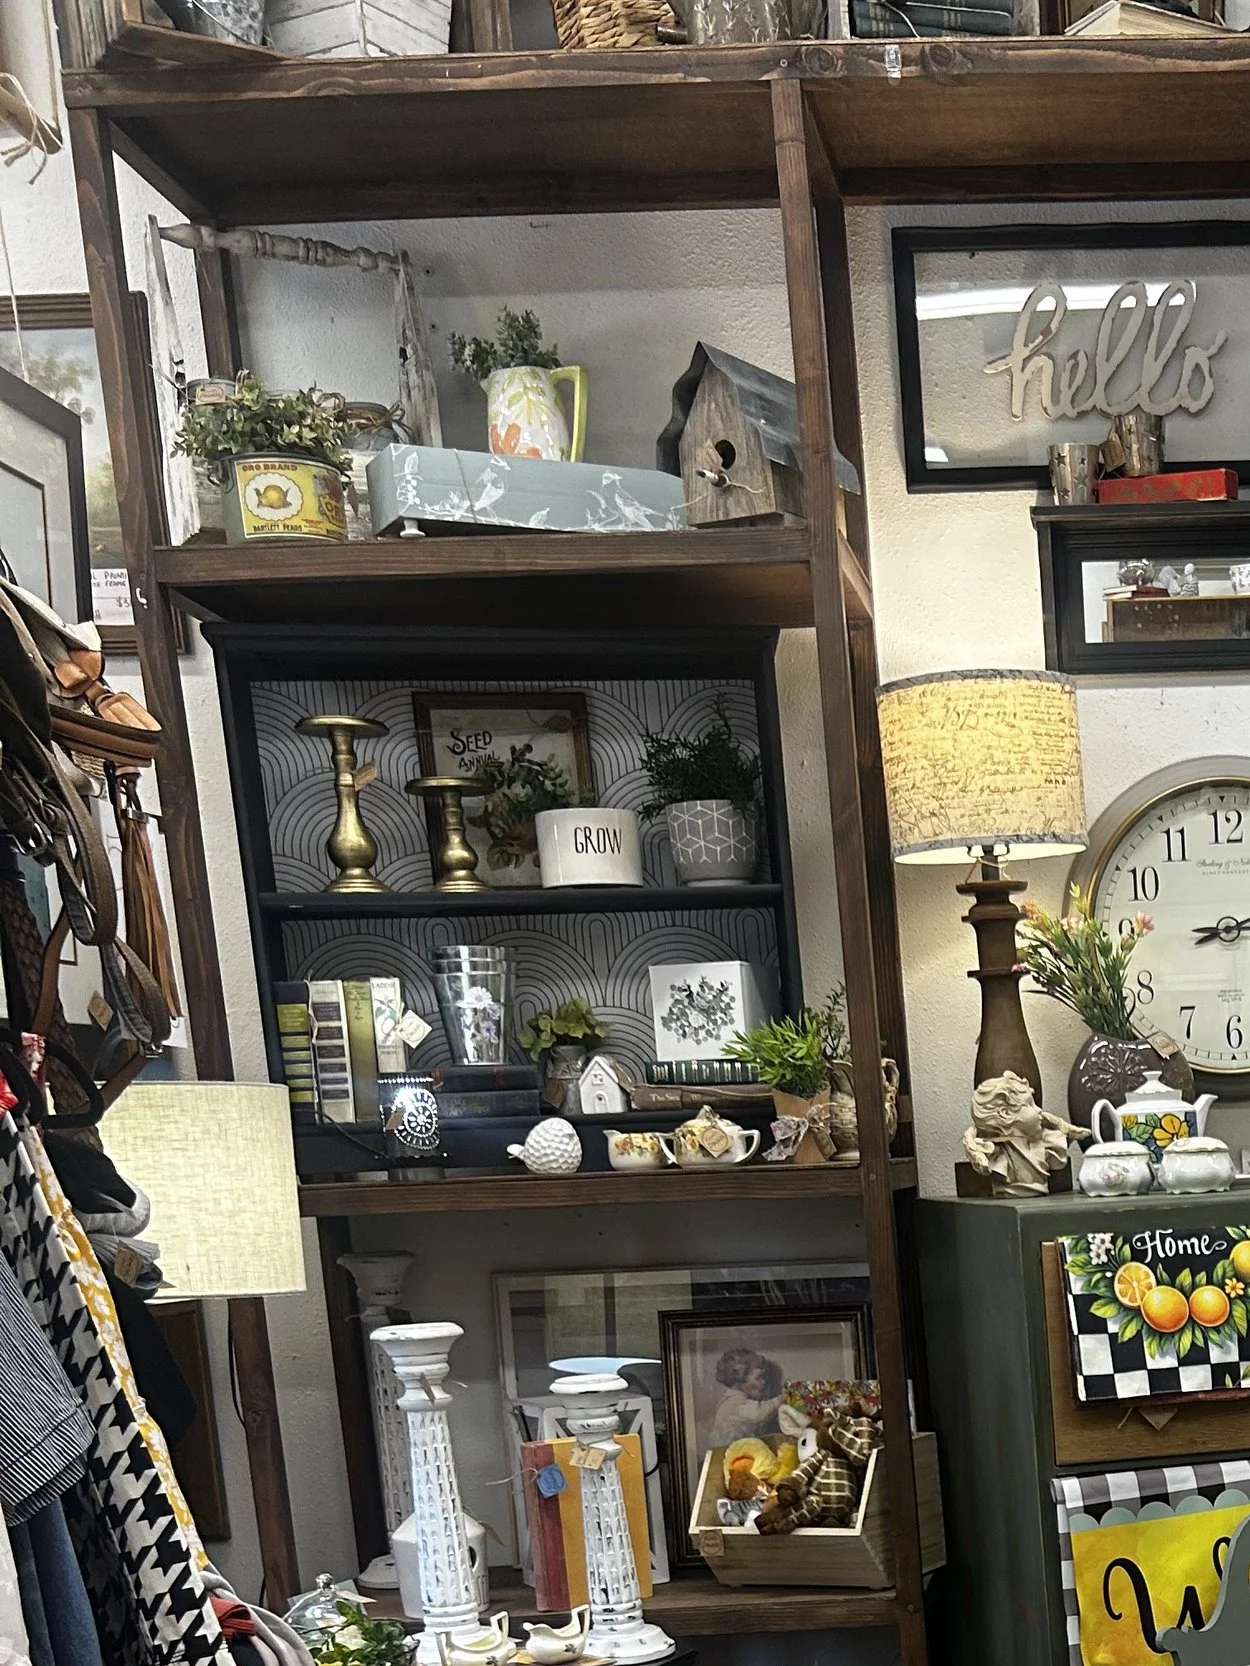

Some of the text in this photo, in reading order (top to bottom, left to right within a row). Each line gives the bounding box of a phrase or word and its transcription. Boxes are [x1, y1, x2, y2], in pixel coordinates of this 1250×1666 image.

[983, 280, 1228, 421] hello
[241, 463, 299, 472] ORO BRAND
[252, 523, 281, 533] BARTLETT
[573, 826, 623, 855] GROW
[1160, 826, 1192, 864] 11
[1207, 809, 1245, 845] 12
[1127, 866, 1160, 902] 10
[1136, 969, 1155, 1006] 8
[1179, 1004, 1197, 1040] 7
[1225, 1015, 1244, 1050] 6
[1131, 1228, 1228, 1264] Home
